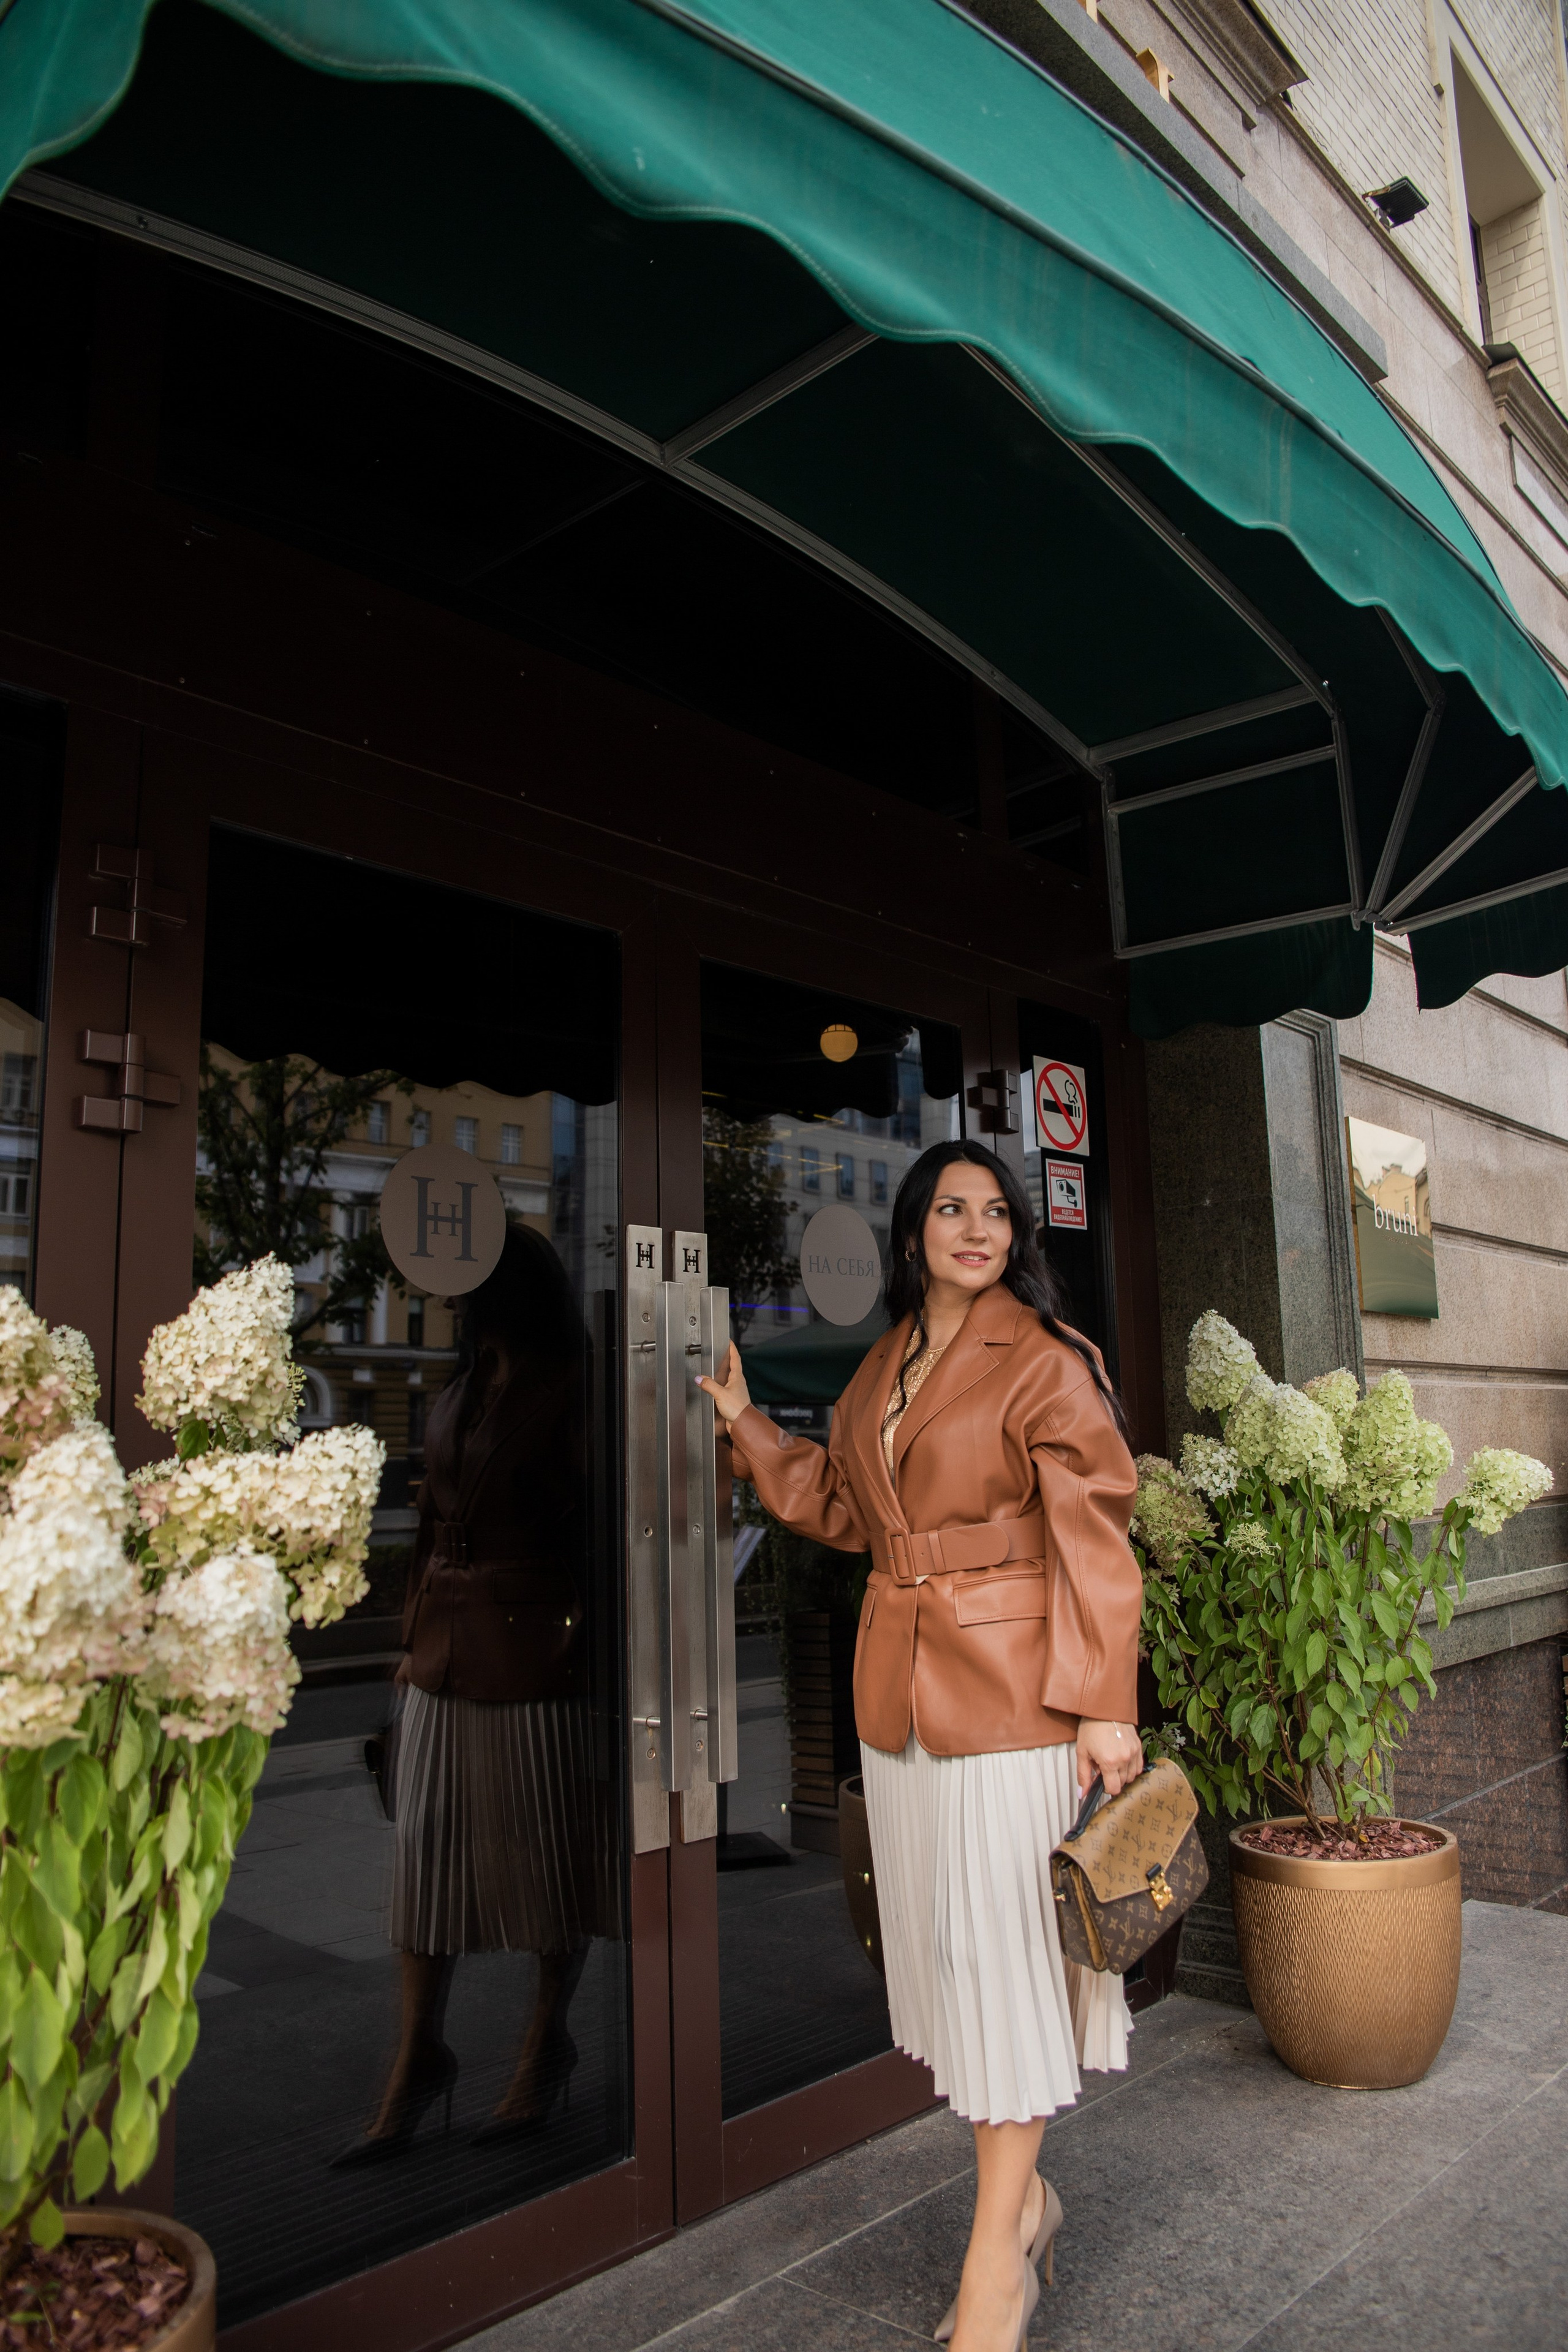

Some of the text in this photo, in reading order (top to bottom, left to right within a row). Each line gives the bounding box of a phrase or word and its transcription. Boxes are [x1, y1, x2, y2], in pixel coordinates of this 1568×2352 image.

[1050, 1166, 1080, 1178] ВНИМАНИЕ!
[1372, 1194, 1419, 1237] bruni
[808, 1255, 875, 1277] НА СЕБЯ
